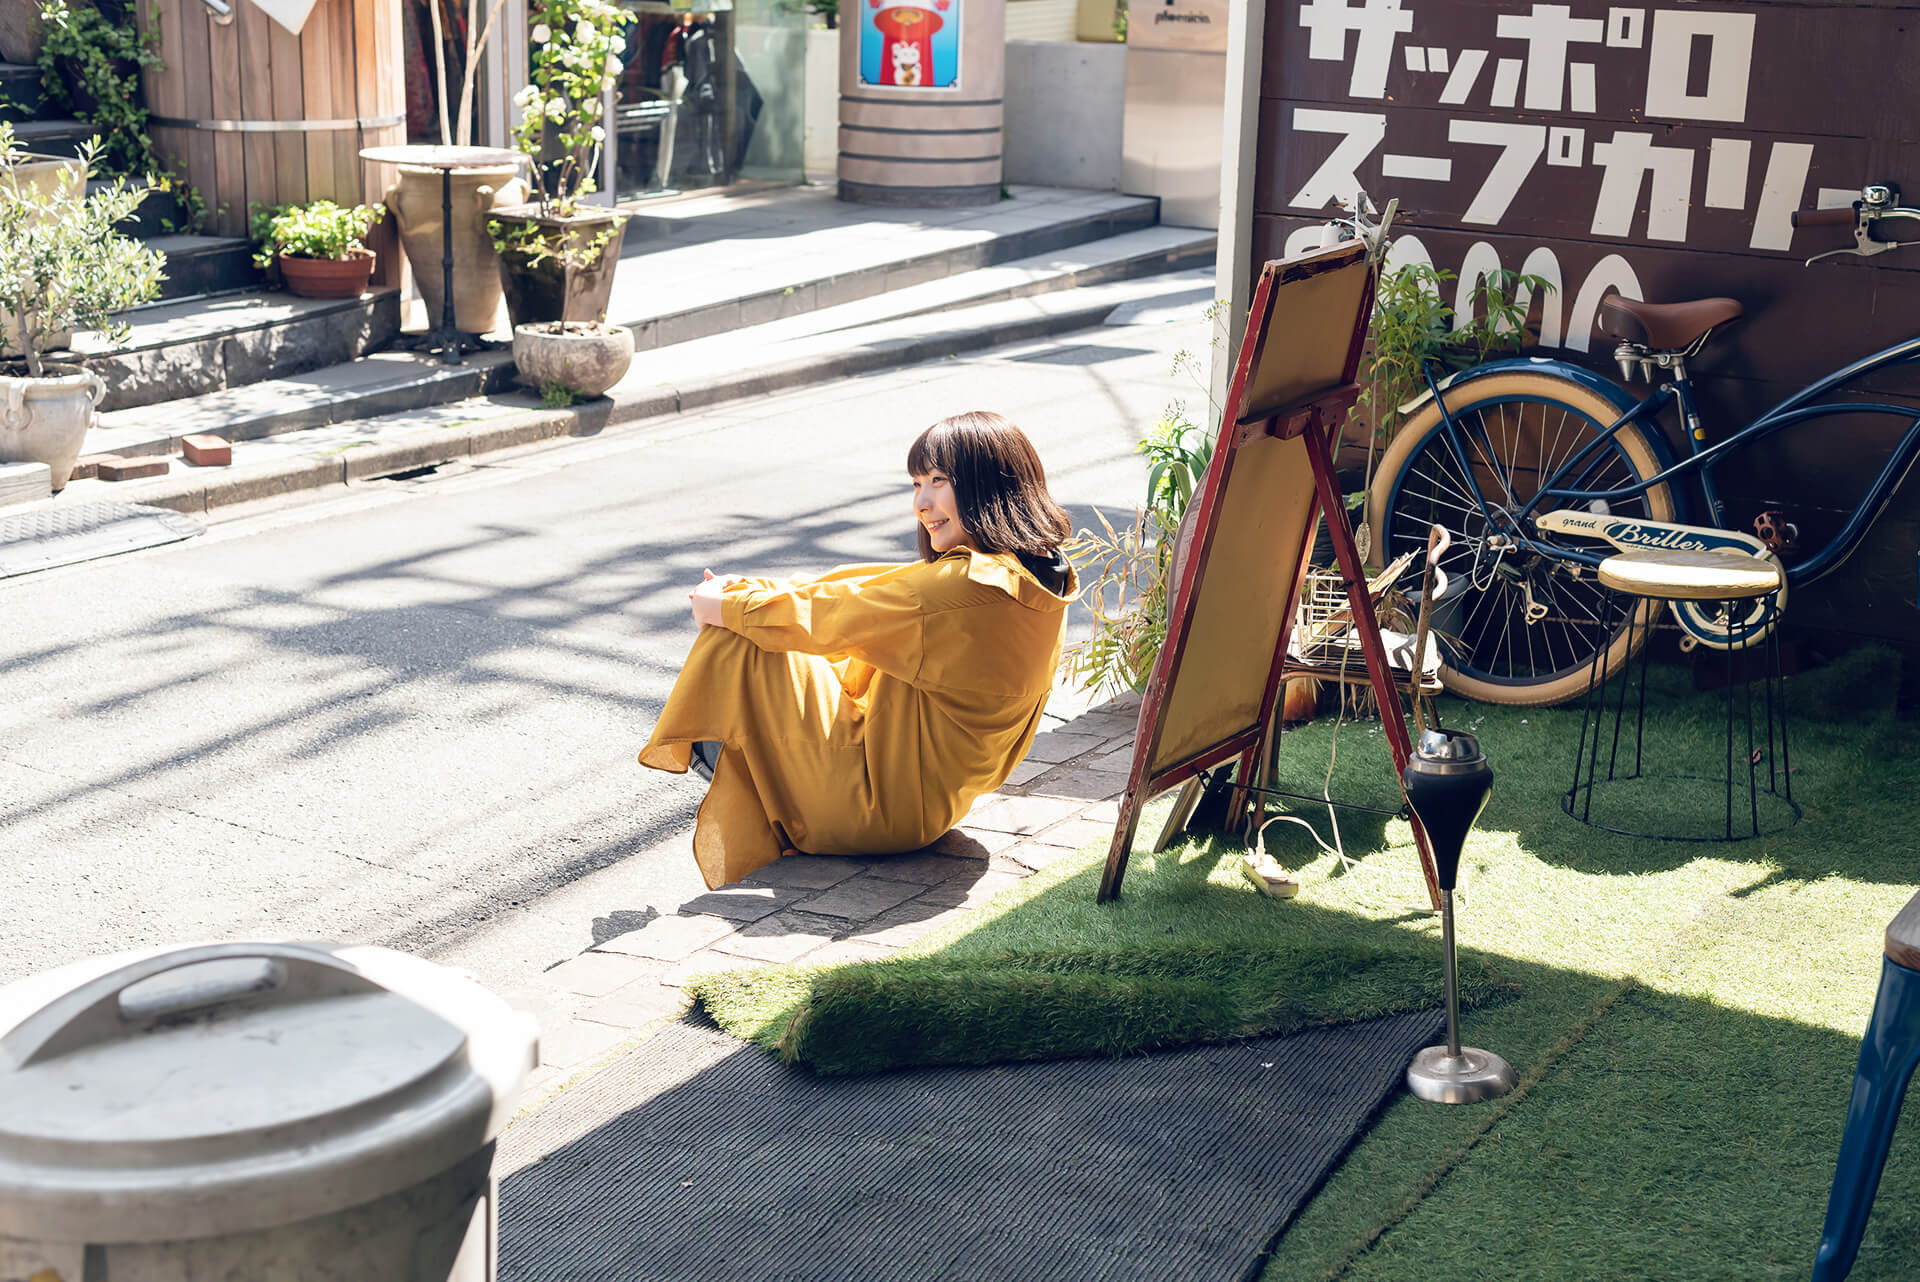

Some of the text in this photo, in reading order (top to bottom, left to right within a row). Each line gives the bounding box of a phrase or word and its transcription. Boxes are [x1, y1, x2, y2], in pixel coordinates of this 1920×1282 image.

[1299, 0, 1756, 123] サッポロ
[1562, 518, 1598, 529] grand
[1603, 523, 1708, 551] Briller
